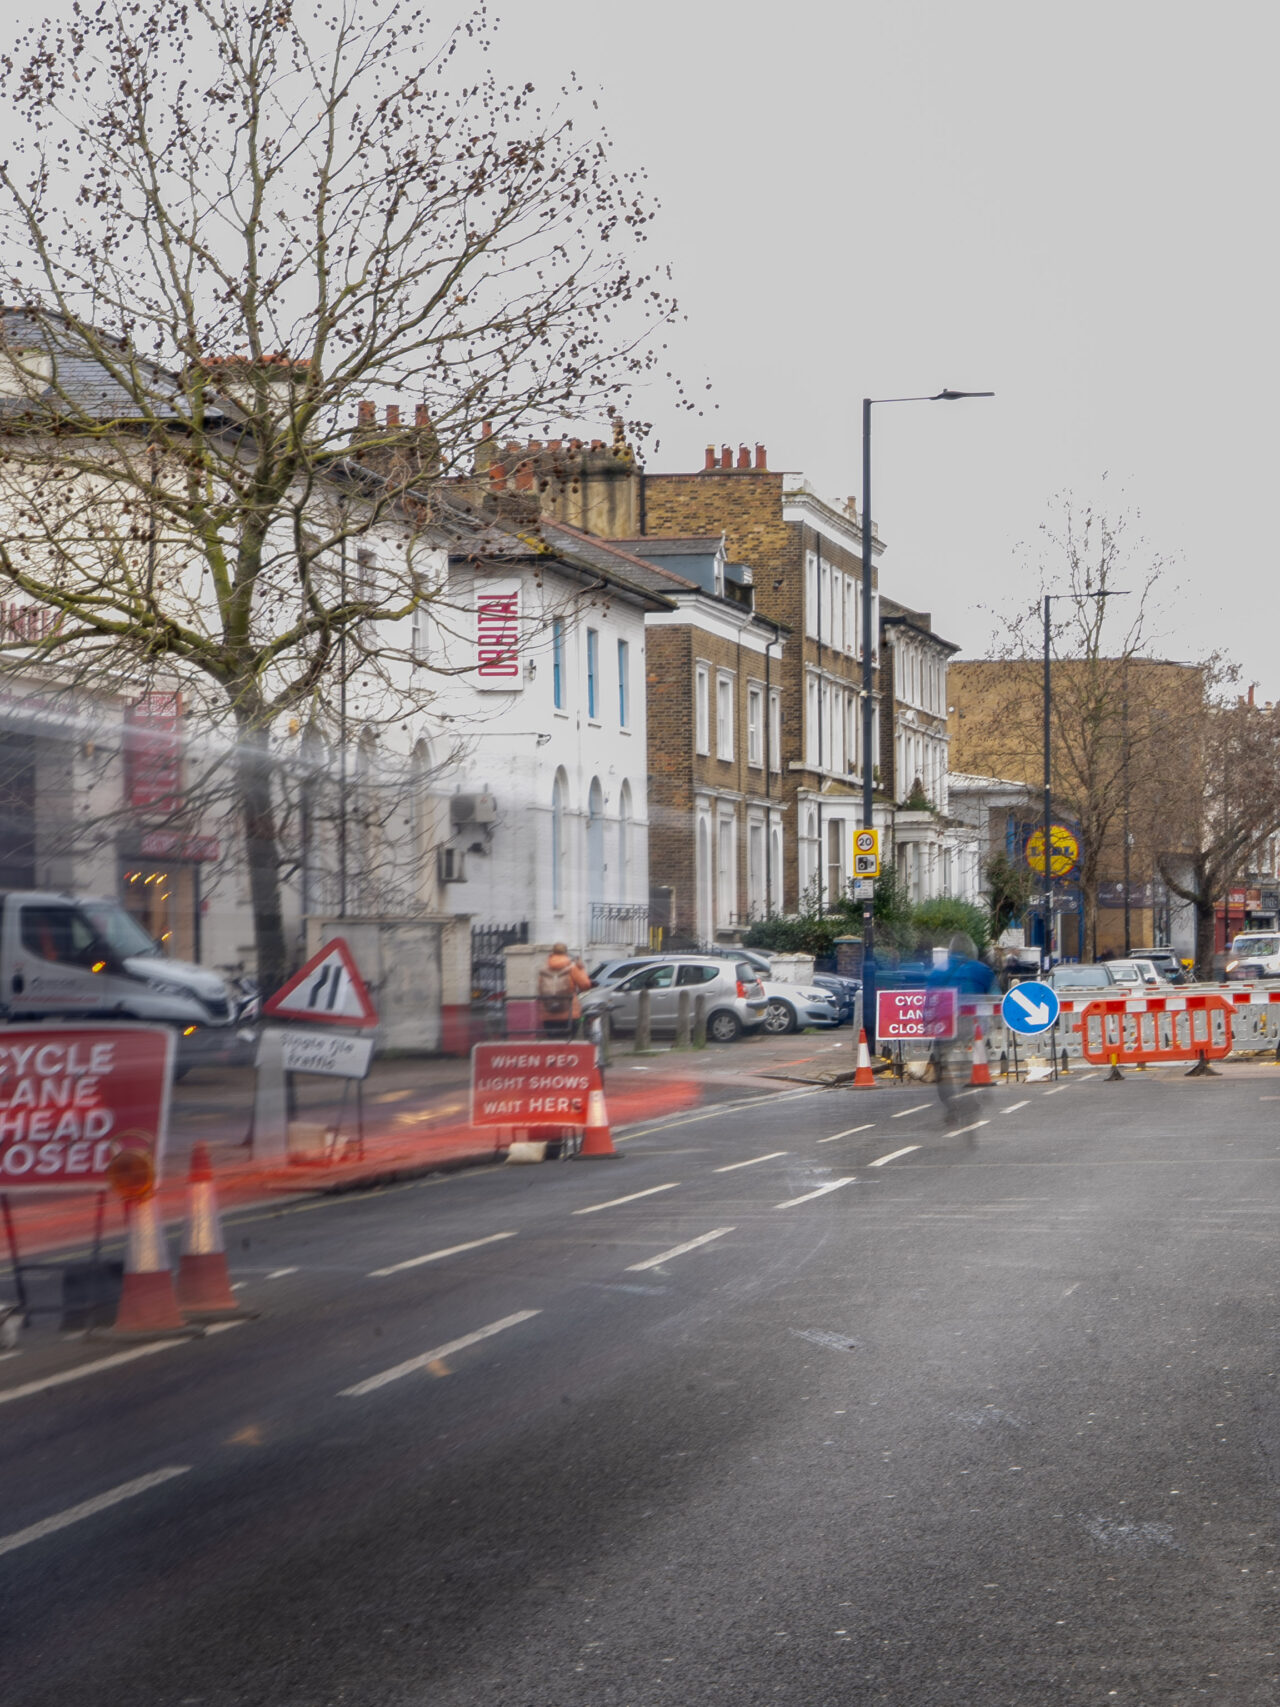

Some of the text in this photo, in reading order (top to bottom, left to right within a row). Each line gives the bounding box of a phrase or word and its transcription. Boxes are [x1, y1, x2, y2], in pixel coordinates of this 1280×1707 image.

[477, 591, 519, 677] ORBITAL
[858, 838, 872, 846] 20
[1030, 846, 1075, 857] LDL
[491, 1054, 579, 1069] WHEN RED
[478, 1076, 590, 1091] LIGHT SHOWS
[483, 1098, 583, 1115] WAIT HERE
[0, 1140, 122, 1176] OSED
